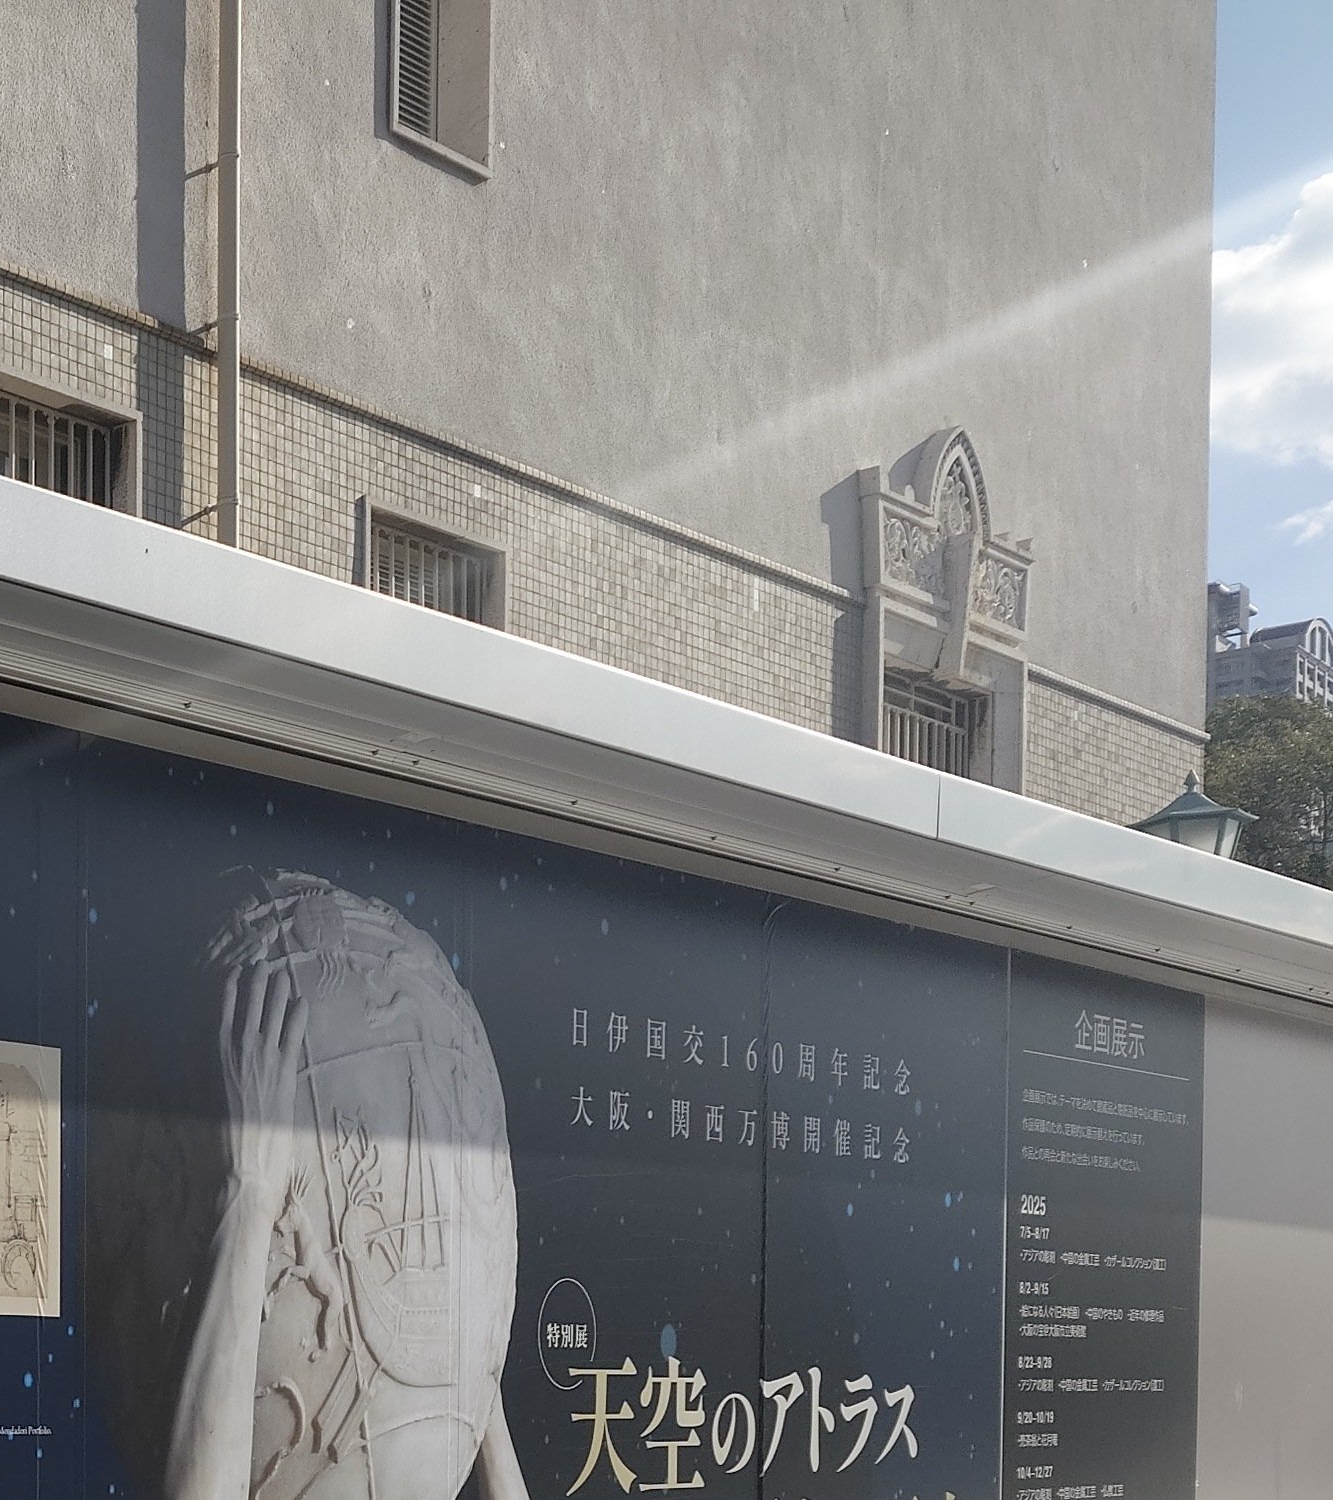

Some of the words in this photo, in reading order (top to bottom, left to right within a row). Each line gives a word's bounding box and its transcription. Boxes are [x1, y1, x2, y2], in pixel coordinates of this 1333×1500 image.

[572, 1008, 911, 1096] 日伊国交160周年記念
[1074, 1009, 1145, 1059] 企画展示
[570, 1086, 911, 1164] 大阪・関西万博開催記念
[1020, 1194, 1046, 1216] 2025
[546, 1322, 589, 1349] 特別展
[565, 1355, 920, 1497] 天空のアトラス
